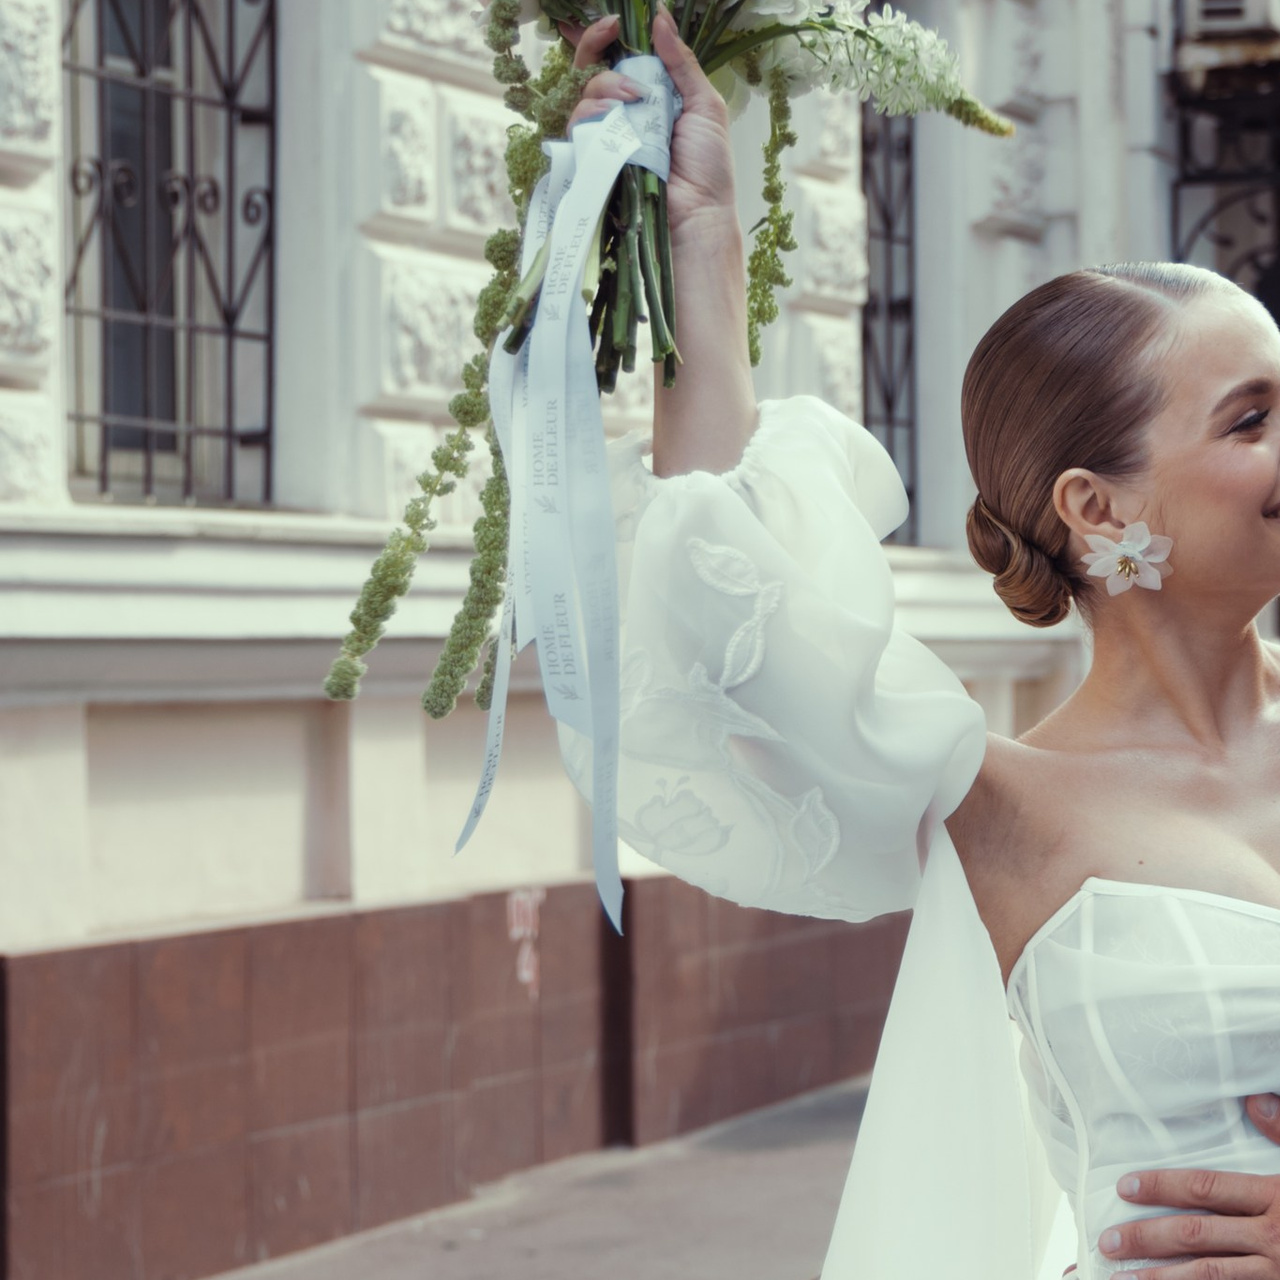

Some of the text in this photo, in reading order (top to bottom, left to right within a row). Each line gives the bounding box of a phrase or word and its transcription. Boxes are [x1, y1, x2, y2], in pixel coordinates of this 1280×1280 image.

[546, 245, 567, 296] HOME
[557, 271, 571, 295] DE
[564, 216, 590, 272] FLEUR
[533, 431, 545, 486] HOME
[546, 398, 559, 486] DE FLEUR
[542, 624, 561, 676] HOME
[553, 592, 577, 676] DE FLEUR
